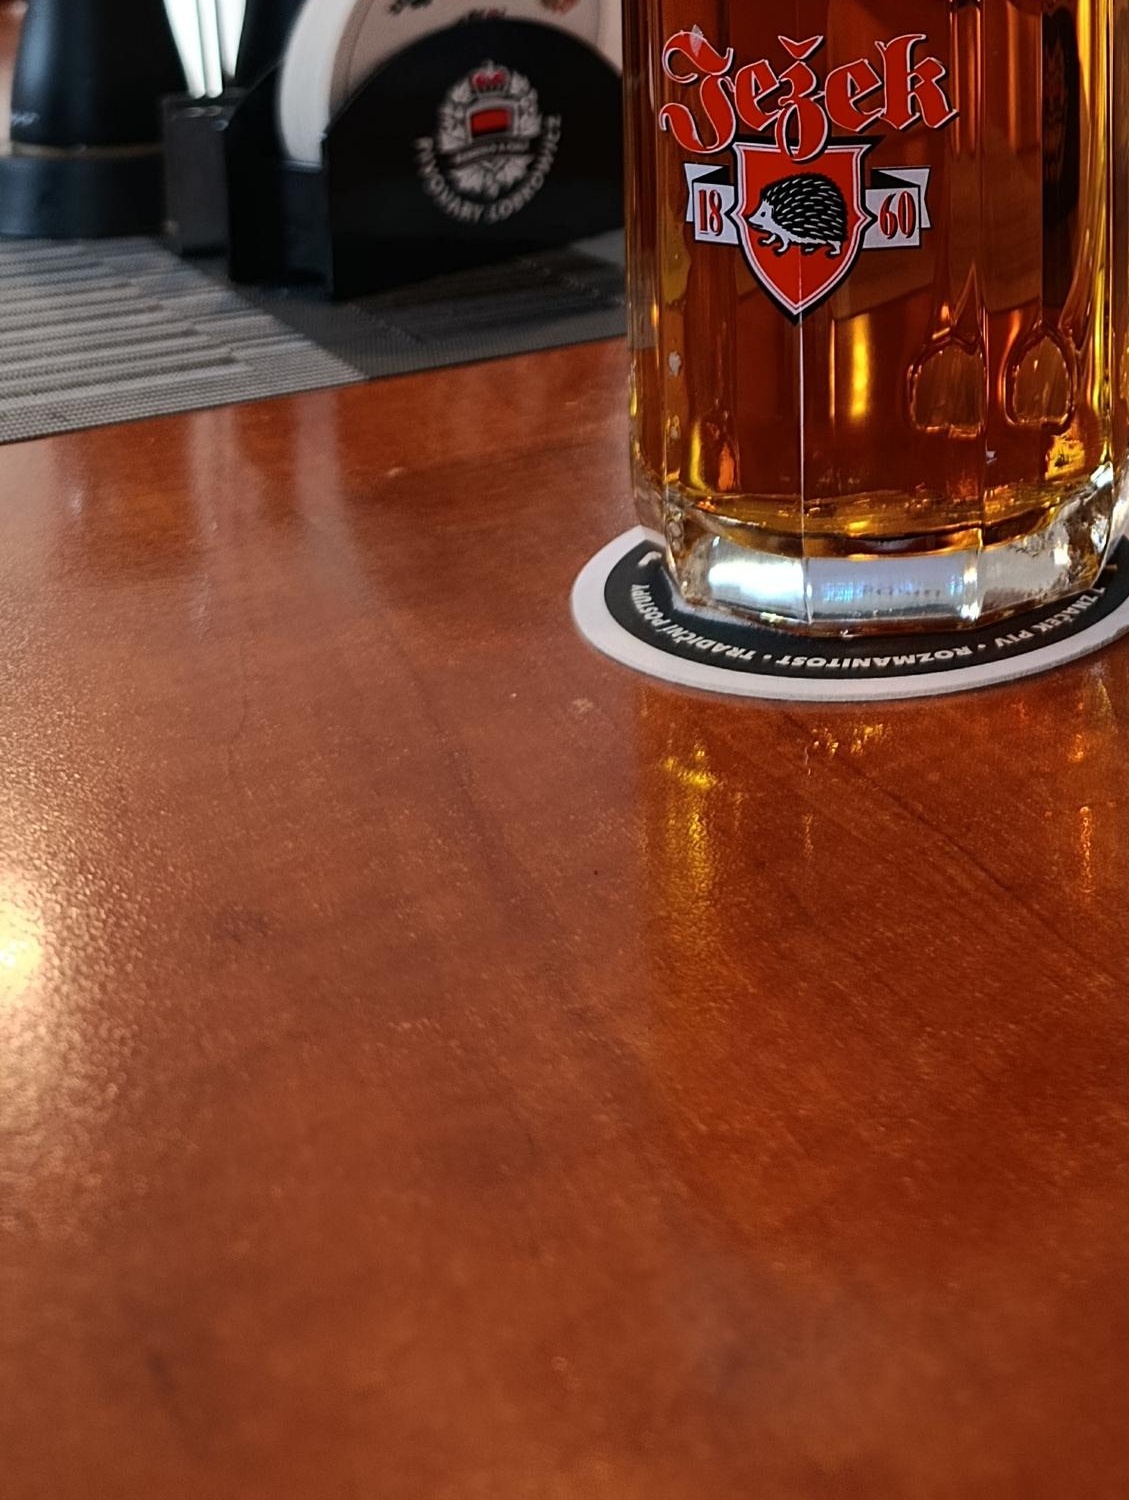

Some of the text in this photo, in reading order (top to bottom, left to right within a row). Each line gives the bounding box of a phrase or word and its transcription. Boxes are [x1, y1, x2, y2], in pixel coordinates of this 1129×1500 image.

[659, 30, 960, 161] Ježek
[698, 189, 916, 240] 18 60
[630, 583, 671, 629] POSTUPY
[660, 623, 757, 661] TRADIČNÍ
[775, 644, 974, 669] ROZMANITOST
[994, 628, 1035, 649] PIV
